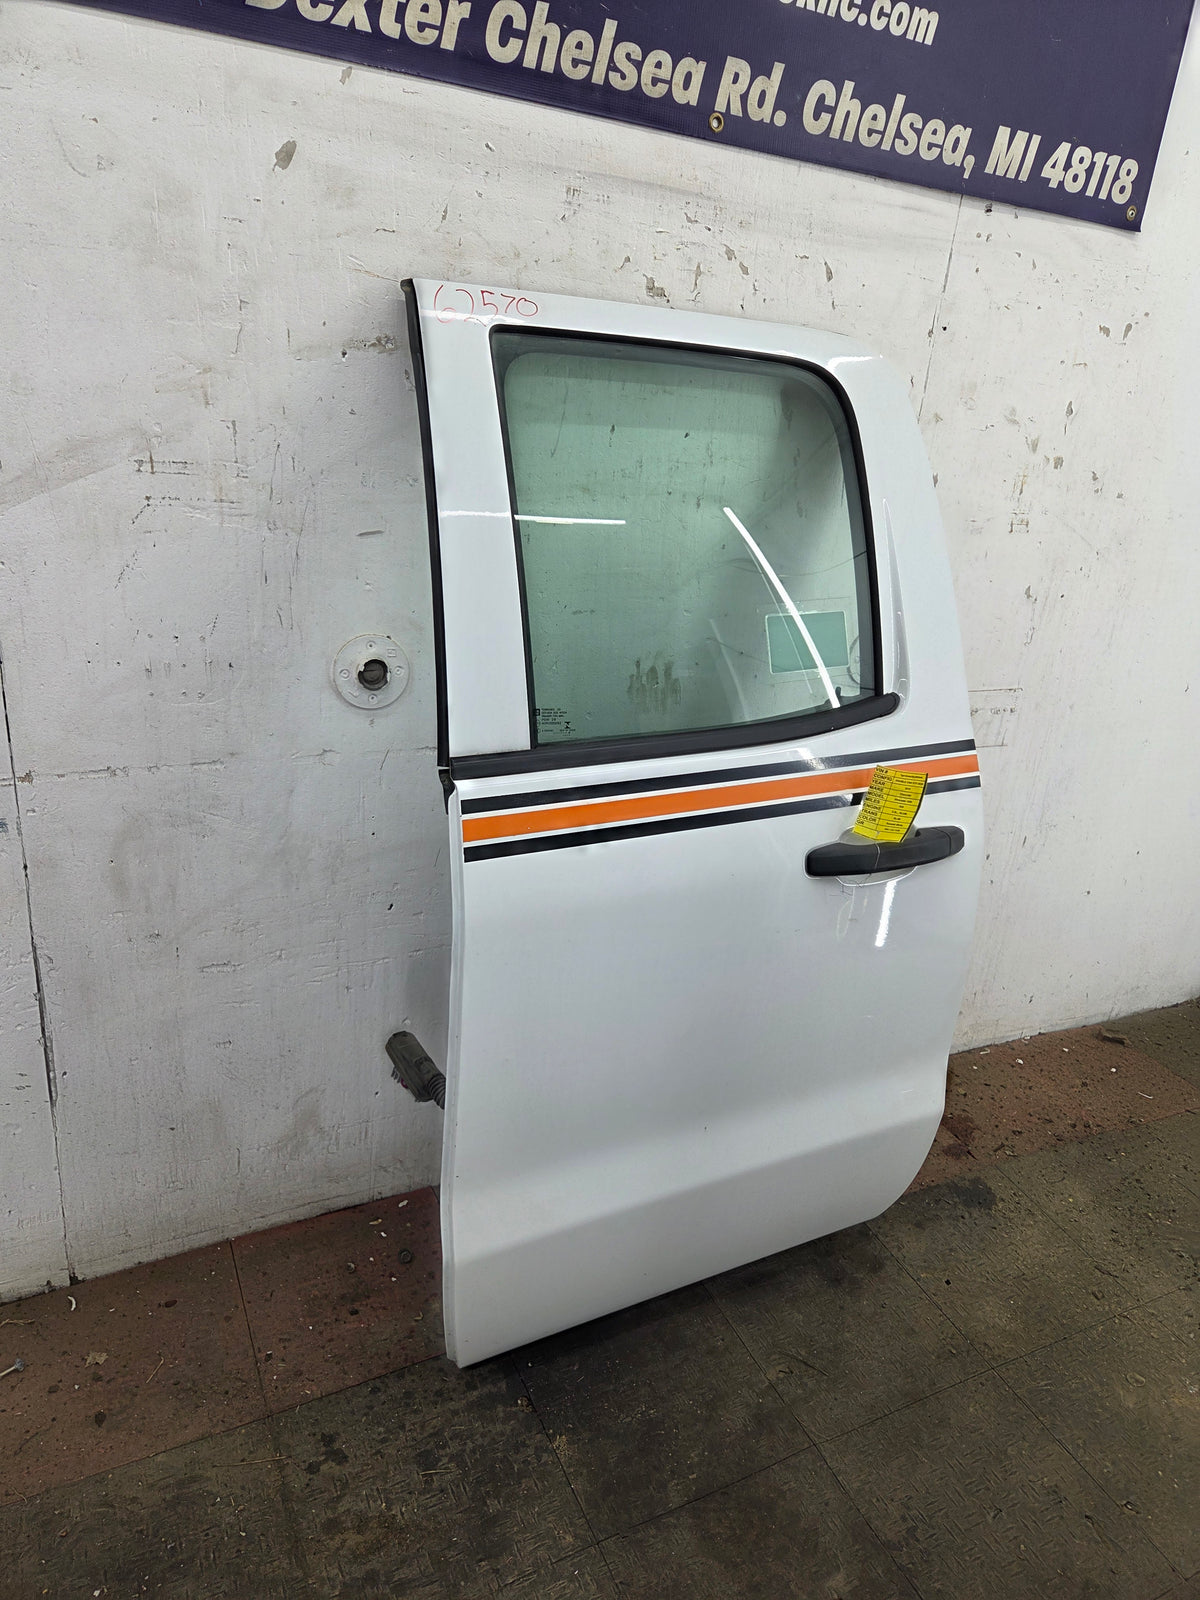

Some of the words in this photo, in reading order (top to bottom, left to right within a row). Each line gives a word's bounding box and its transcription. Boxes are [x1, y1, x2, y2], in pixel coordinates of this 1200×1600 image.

[485, 0, 707, 106] Chelsea
[714, 56, 787, 127] Rd.
[803, 80, 976, 179] Chelsea,
[984, 125, 1041, 181] MI
[1041, 142, 1139, 204] 48118
[433, 284, 539, 327] 62570
